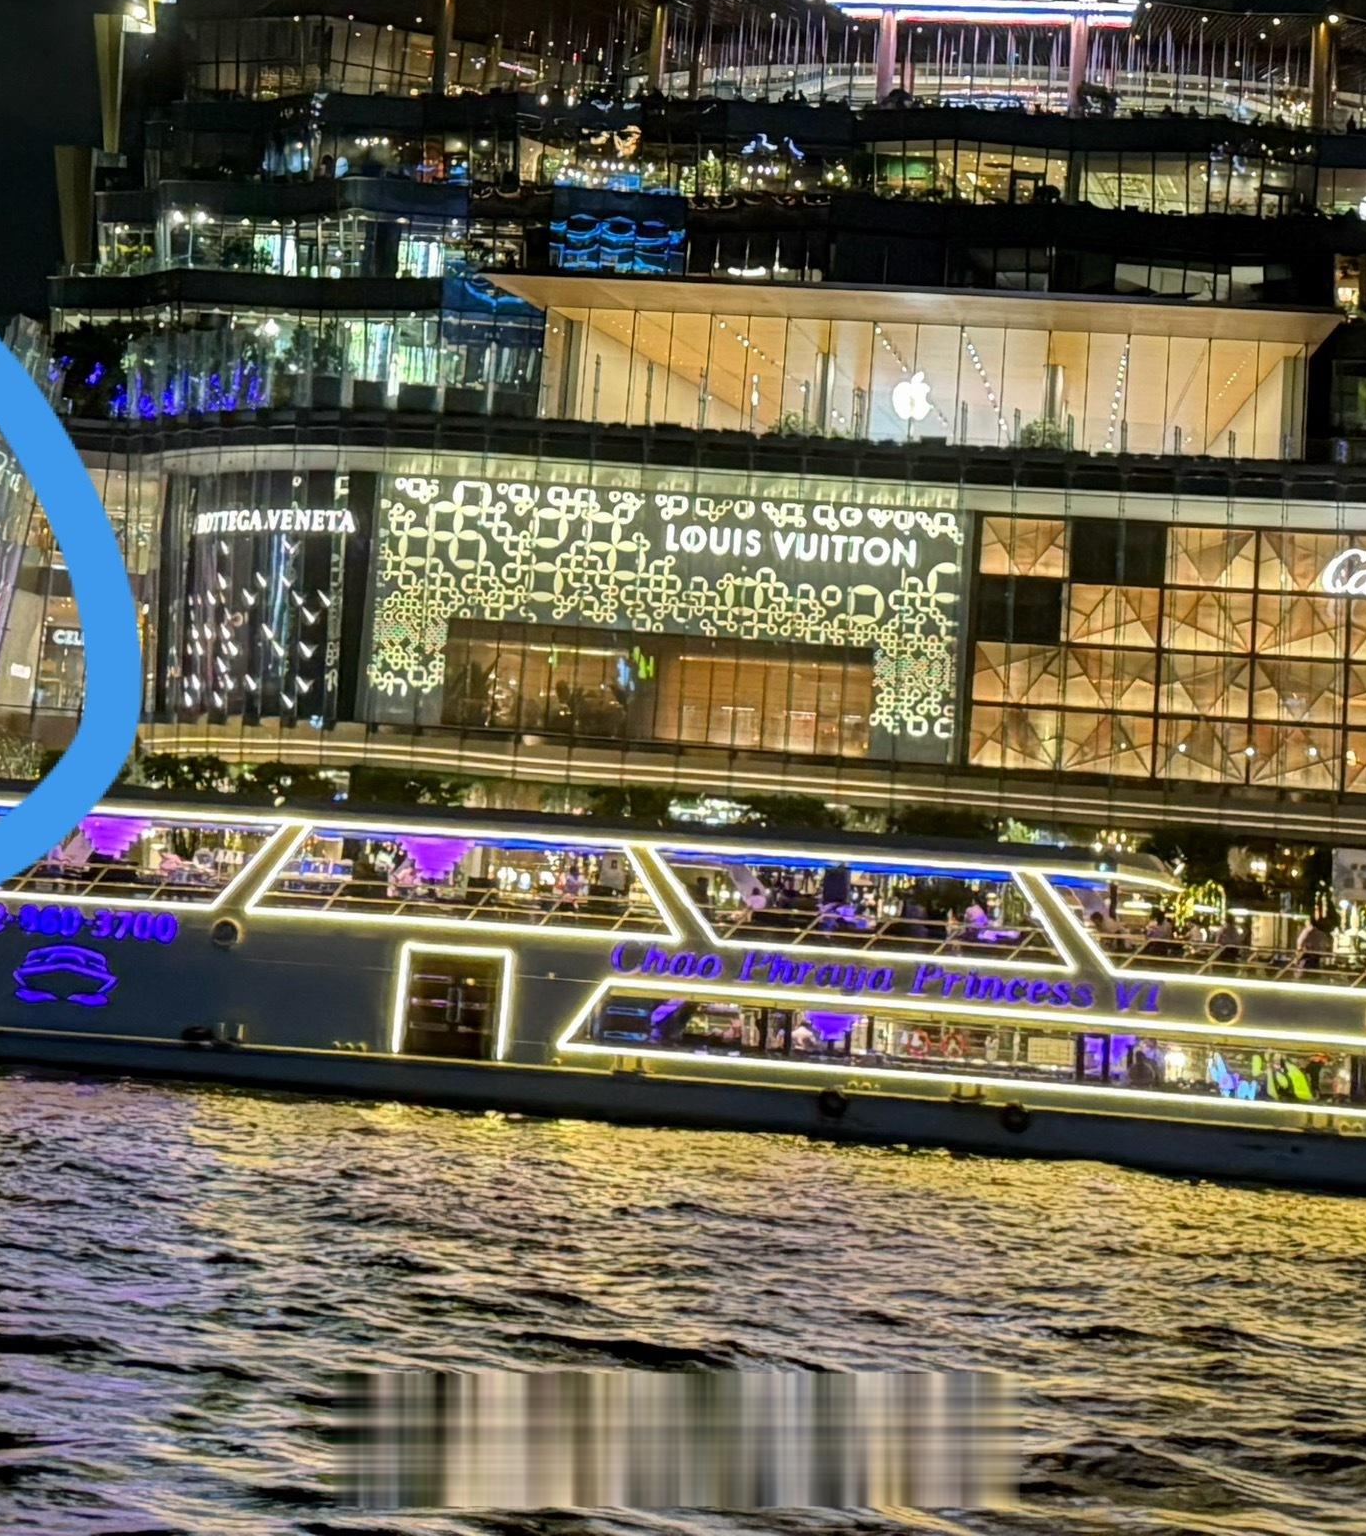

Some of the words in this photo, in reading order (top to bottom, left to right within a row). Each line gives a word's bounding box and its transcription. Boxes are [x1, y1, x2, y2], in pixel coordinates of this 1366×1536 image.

[193, 509, 262, 534] BOTTEGA
[266, 508, 356, 533] VENETA
[665, 523, 762, 557] LOUIS
[772, 530, 918, 568] VUITTON
[52, 629, 85, 645] CEL
[611, 942, 724, 980] Chao
[737, 948, 895, 995] Phraya
[908, 962, 1095, 1009] Princess
